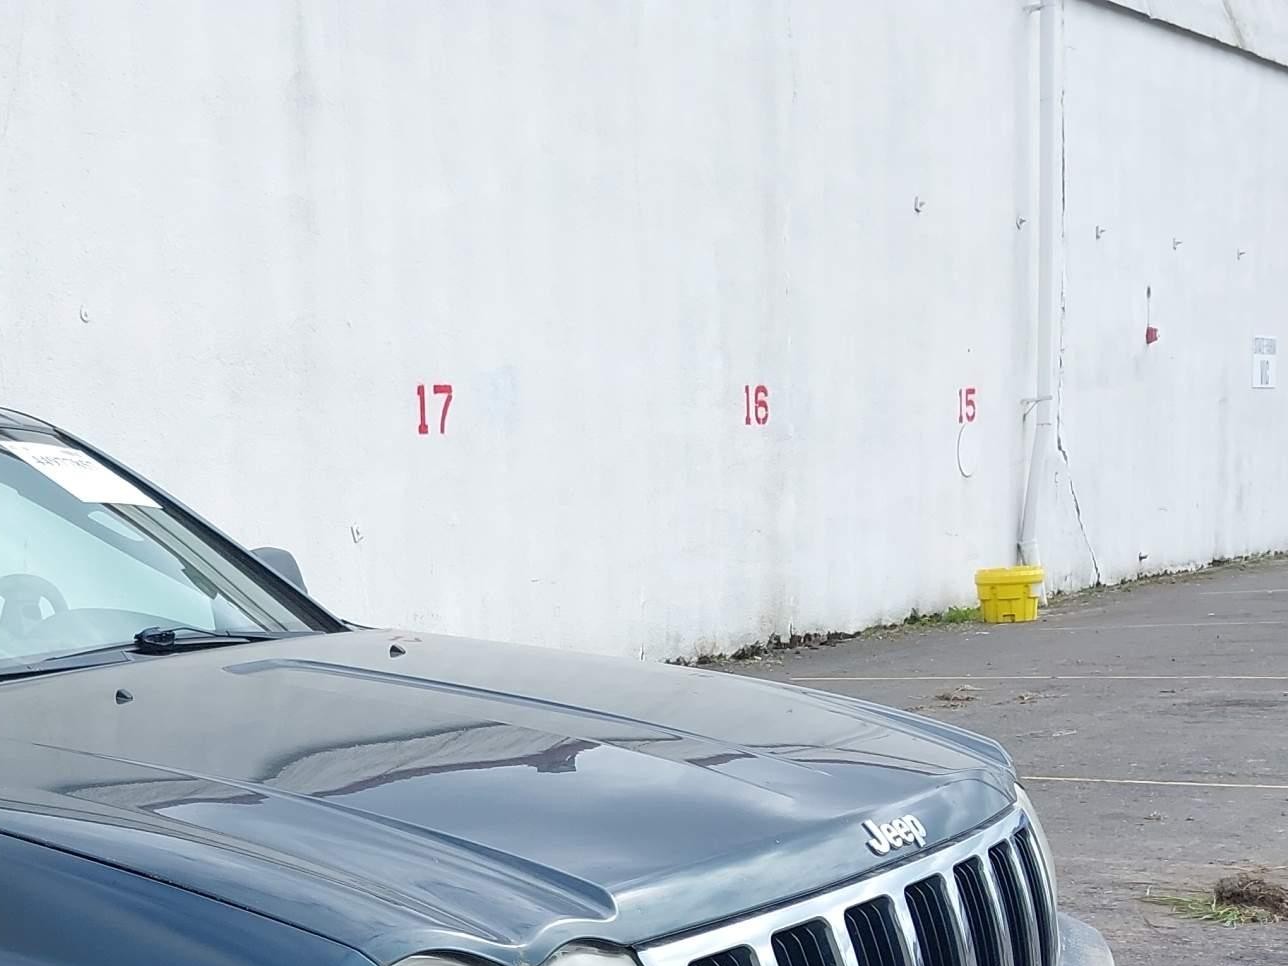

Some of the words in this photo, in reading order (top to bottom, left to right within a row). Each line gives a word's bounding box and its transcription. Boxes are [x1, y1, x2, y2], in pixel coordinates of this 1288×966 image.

[416, 383, 453, 435] 17
[744, 384, 769, 425] 16
[958, 388, 976, 424] 15
[861, 814, 927, 856] Jeep
